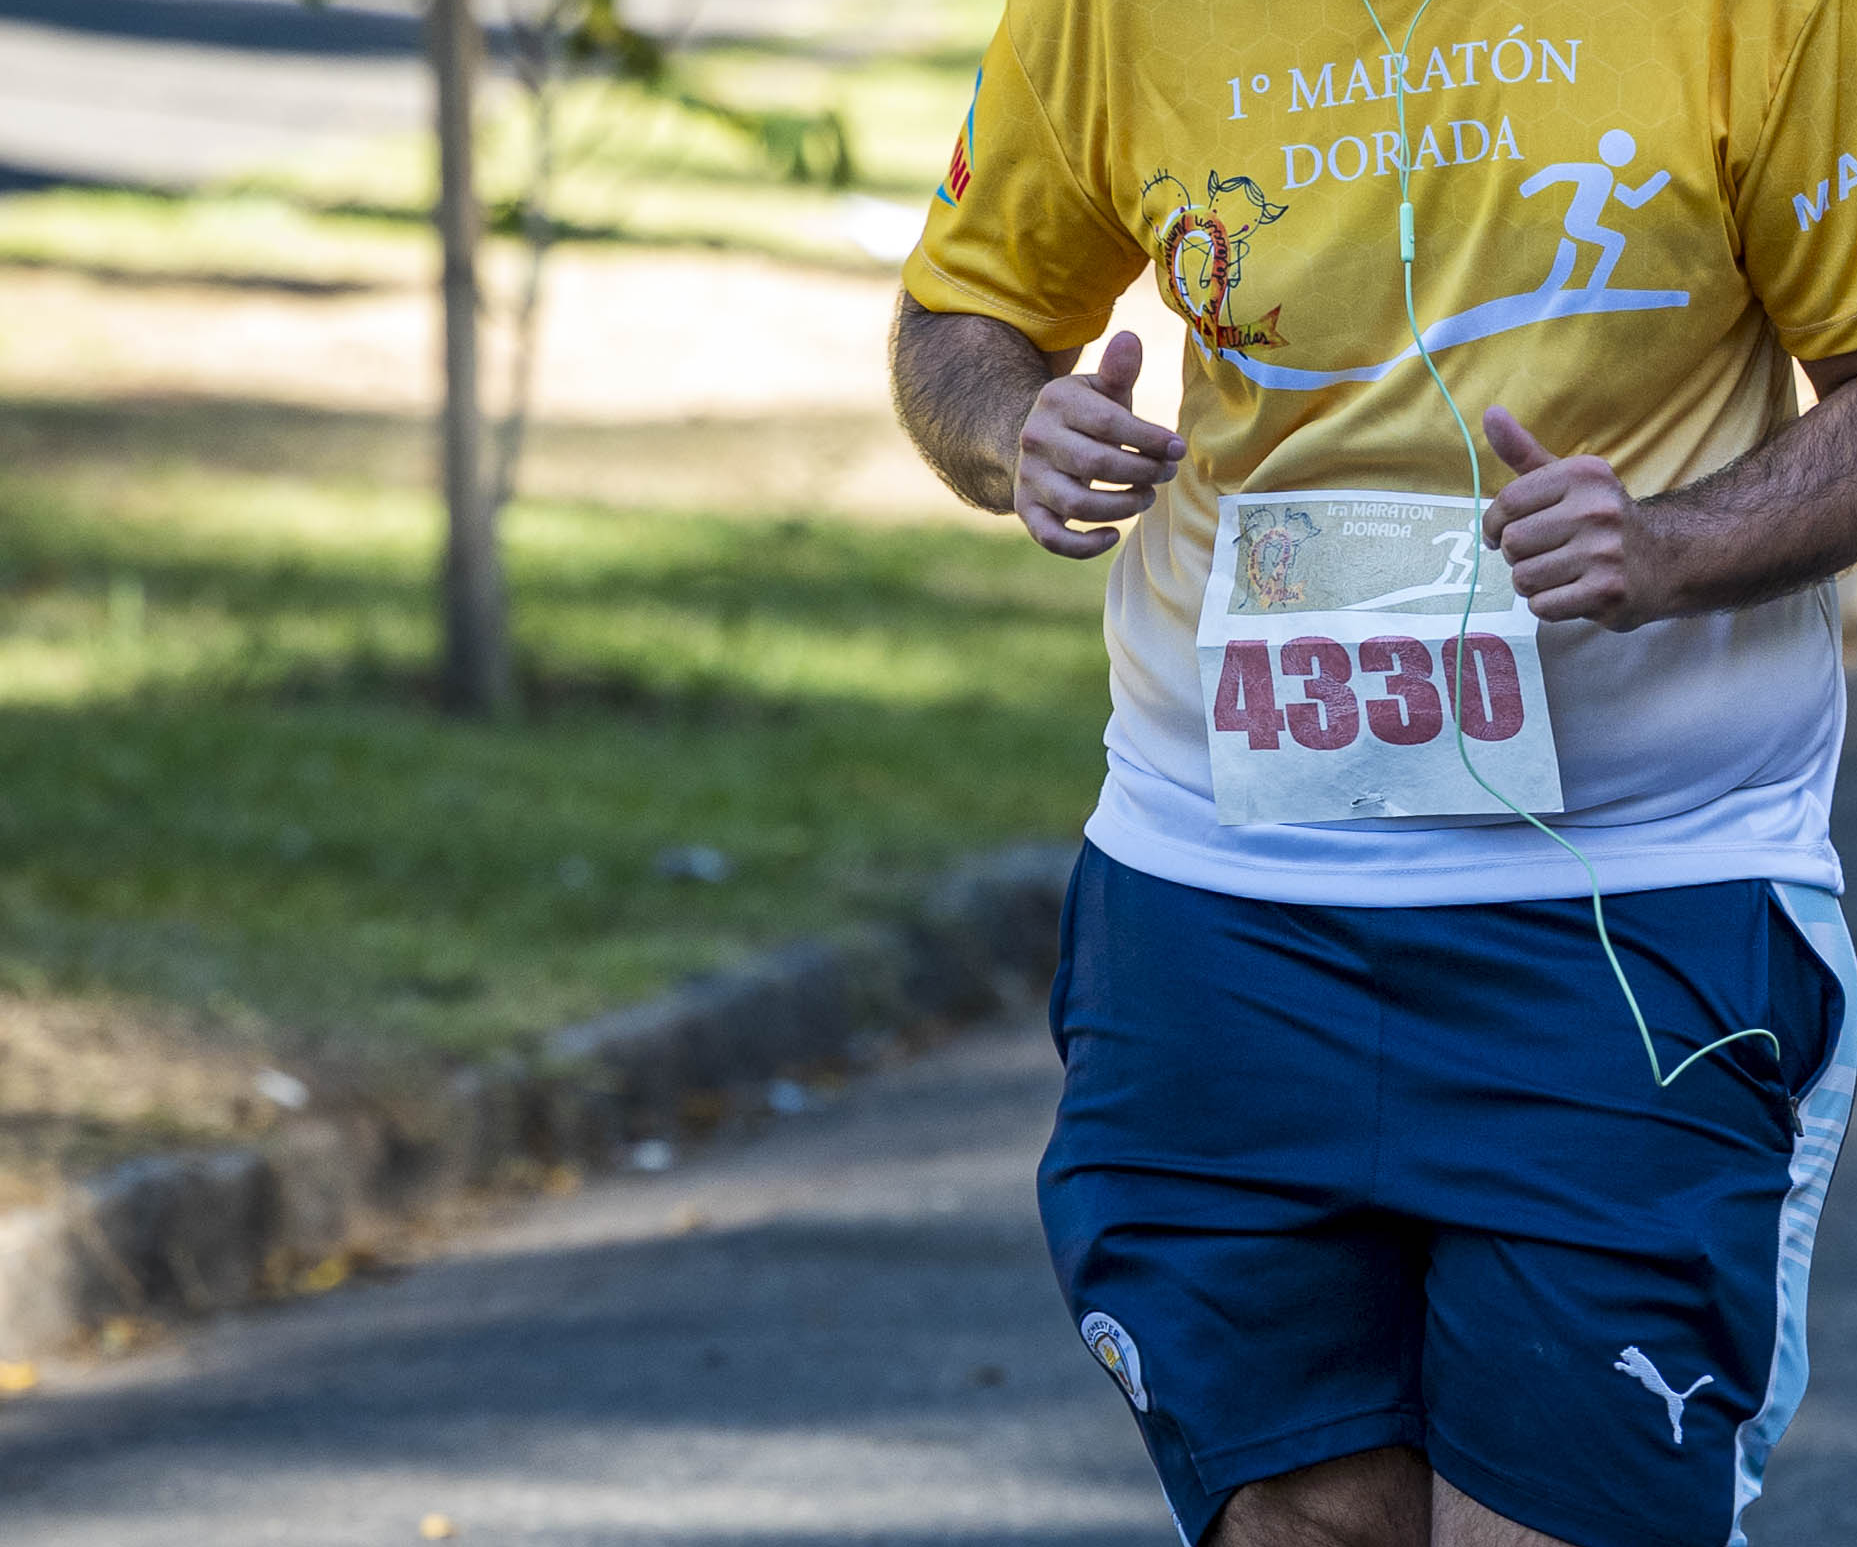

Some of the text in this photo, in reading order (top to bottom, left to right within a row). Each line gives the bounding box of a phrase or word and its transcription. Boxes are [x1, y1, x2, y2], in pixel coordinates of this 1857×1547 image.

[1287, 23, 1583, 114] MARATÓN
[1280, 115, 1525, 191] DORADA
[1342, 521, 1412, 538] DORADA
[1351, 502, 1435, 521] MARATON
[1213, 631, 1525, 751] 4330
